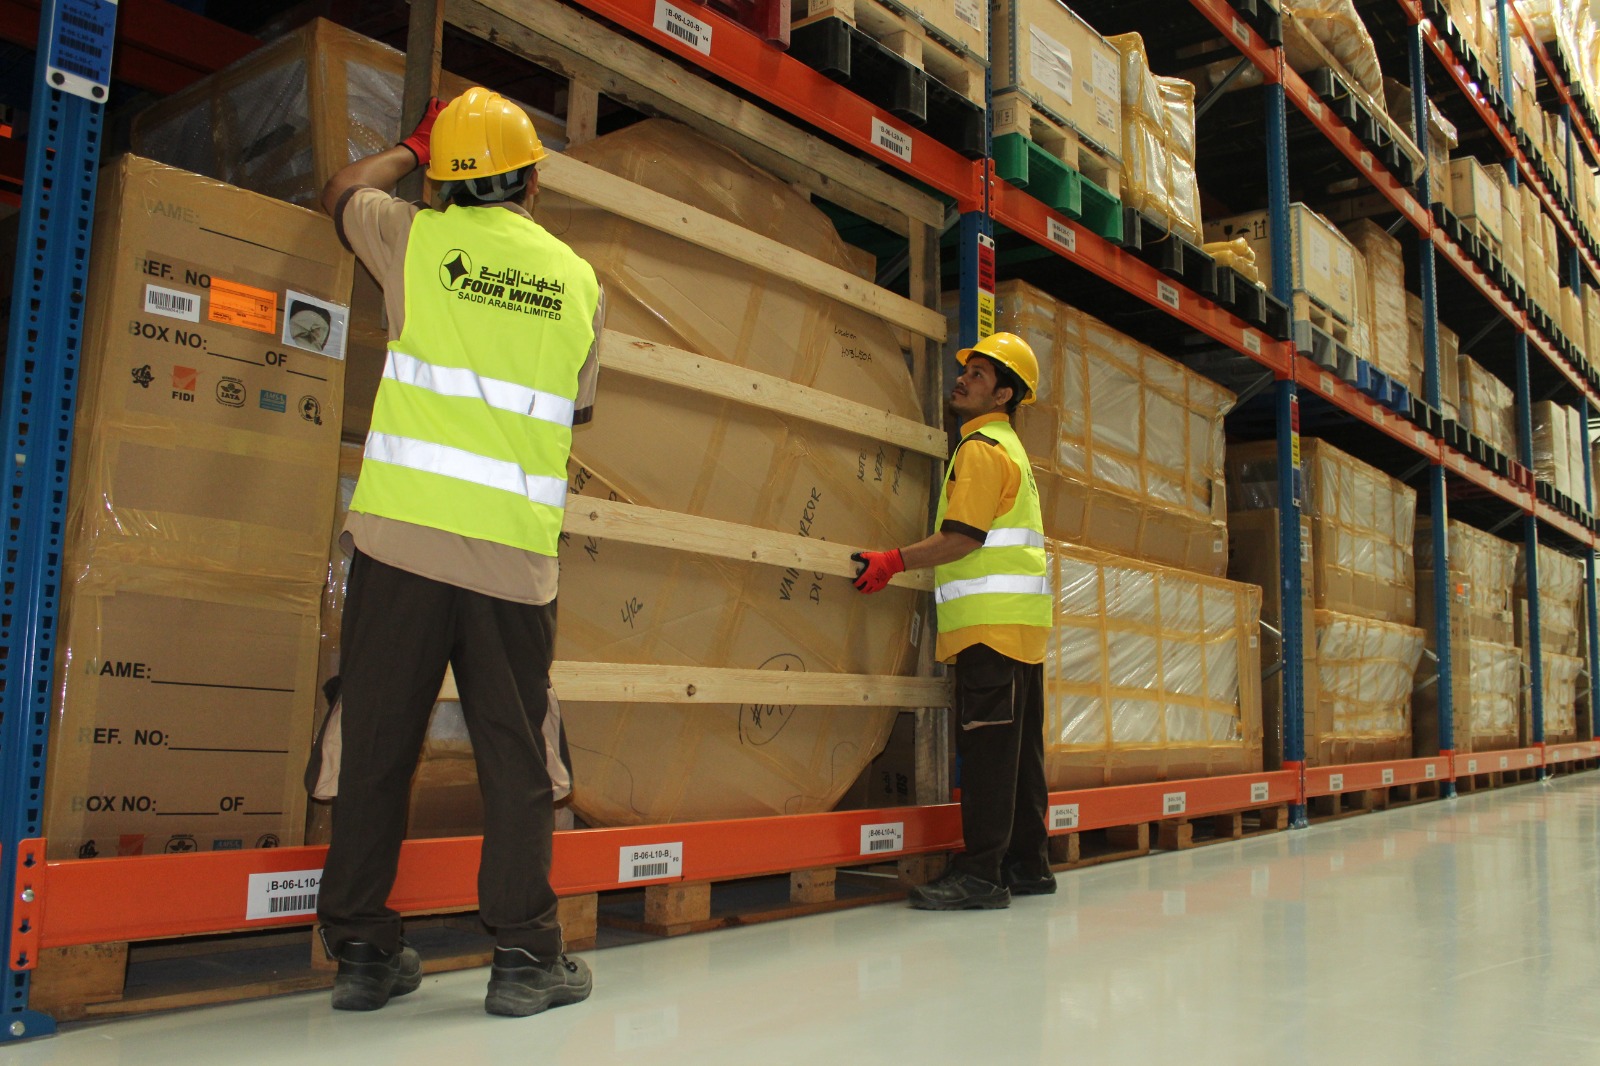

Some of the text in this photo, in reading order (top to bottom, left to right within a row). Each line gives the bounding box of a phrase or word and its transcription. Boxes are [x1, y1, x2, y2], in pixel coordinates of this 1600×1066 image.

[668, 8, 700, 32] B-06-L20-B
[450, 157, 478, 172] 362
[460, 277, 563, 311] FOUR WINDS
[457, 291, 562, 321] SAUDI ARABIA LIMITED
[128, 320, 208, 351] BOX NO:
[265, 351, 287, 367] OF
[171, 390, 195, 403] FIDI
[221, 391, 240, 401] IATA
[84, 660, 152, 679] NAME:
[78, 726, 169, 746] REF. NO:
[71, 795, 157, 812] BOX NO:
[219, 796, 245, 812] OF
[633, 849, 669, 860] B-06-L10-B
[271, 878, 321, 890] B-06-L10-
